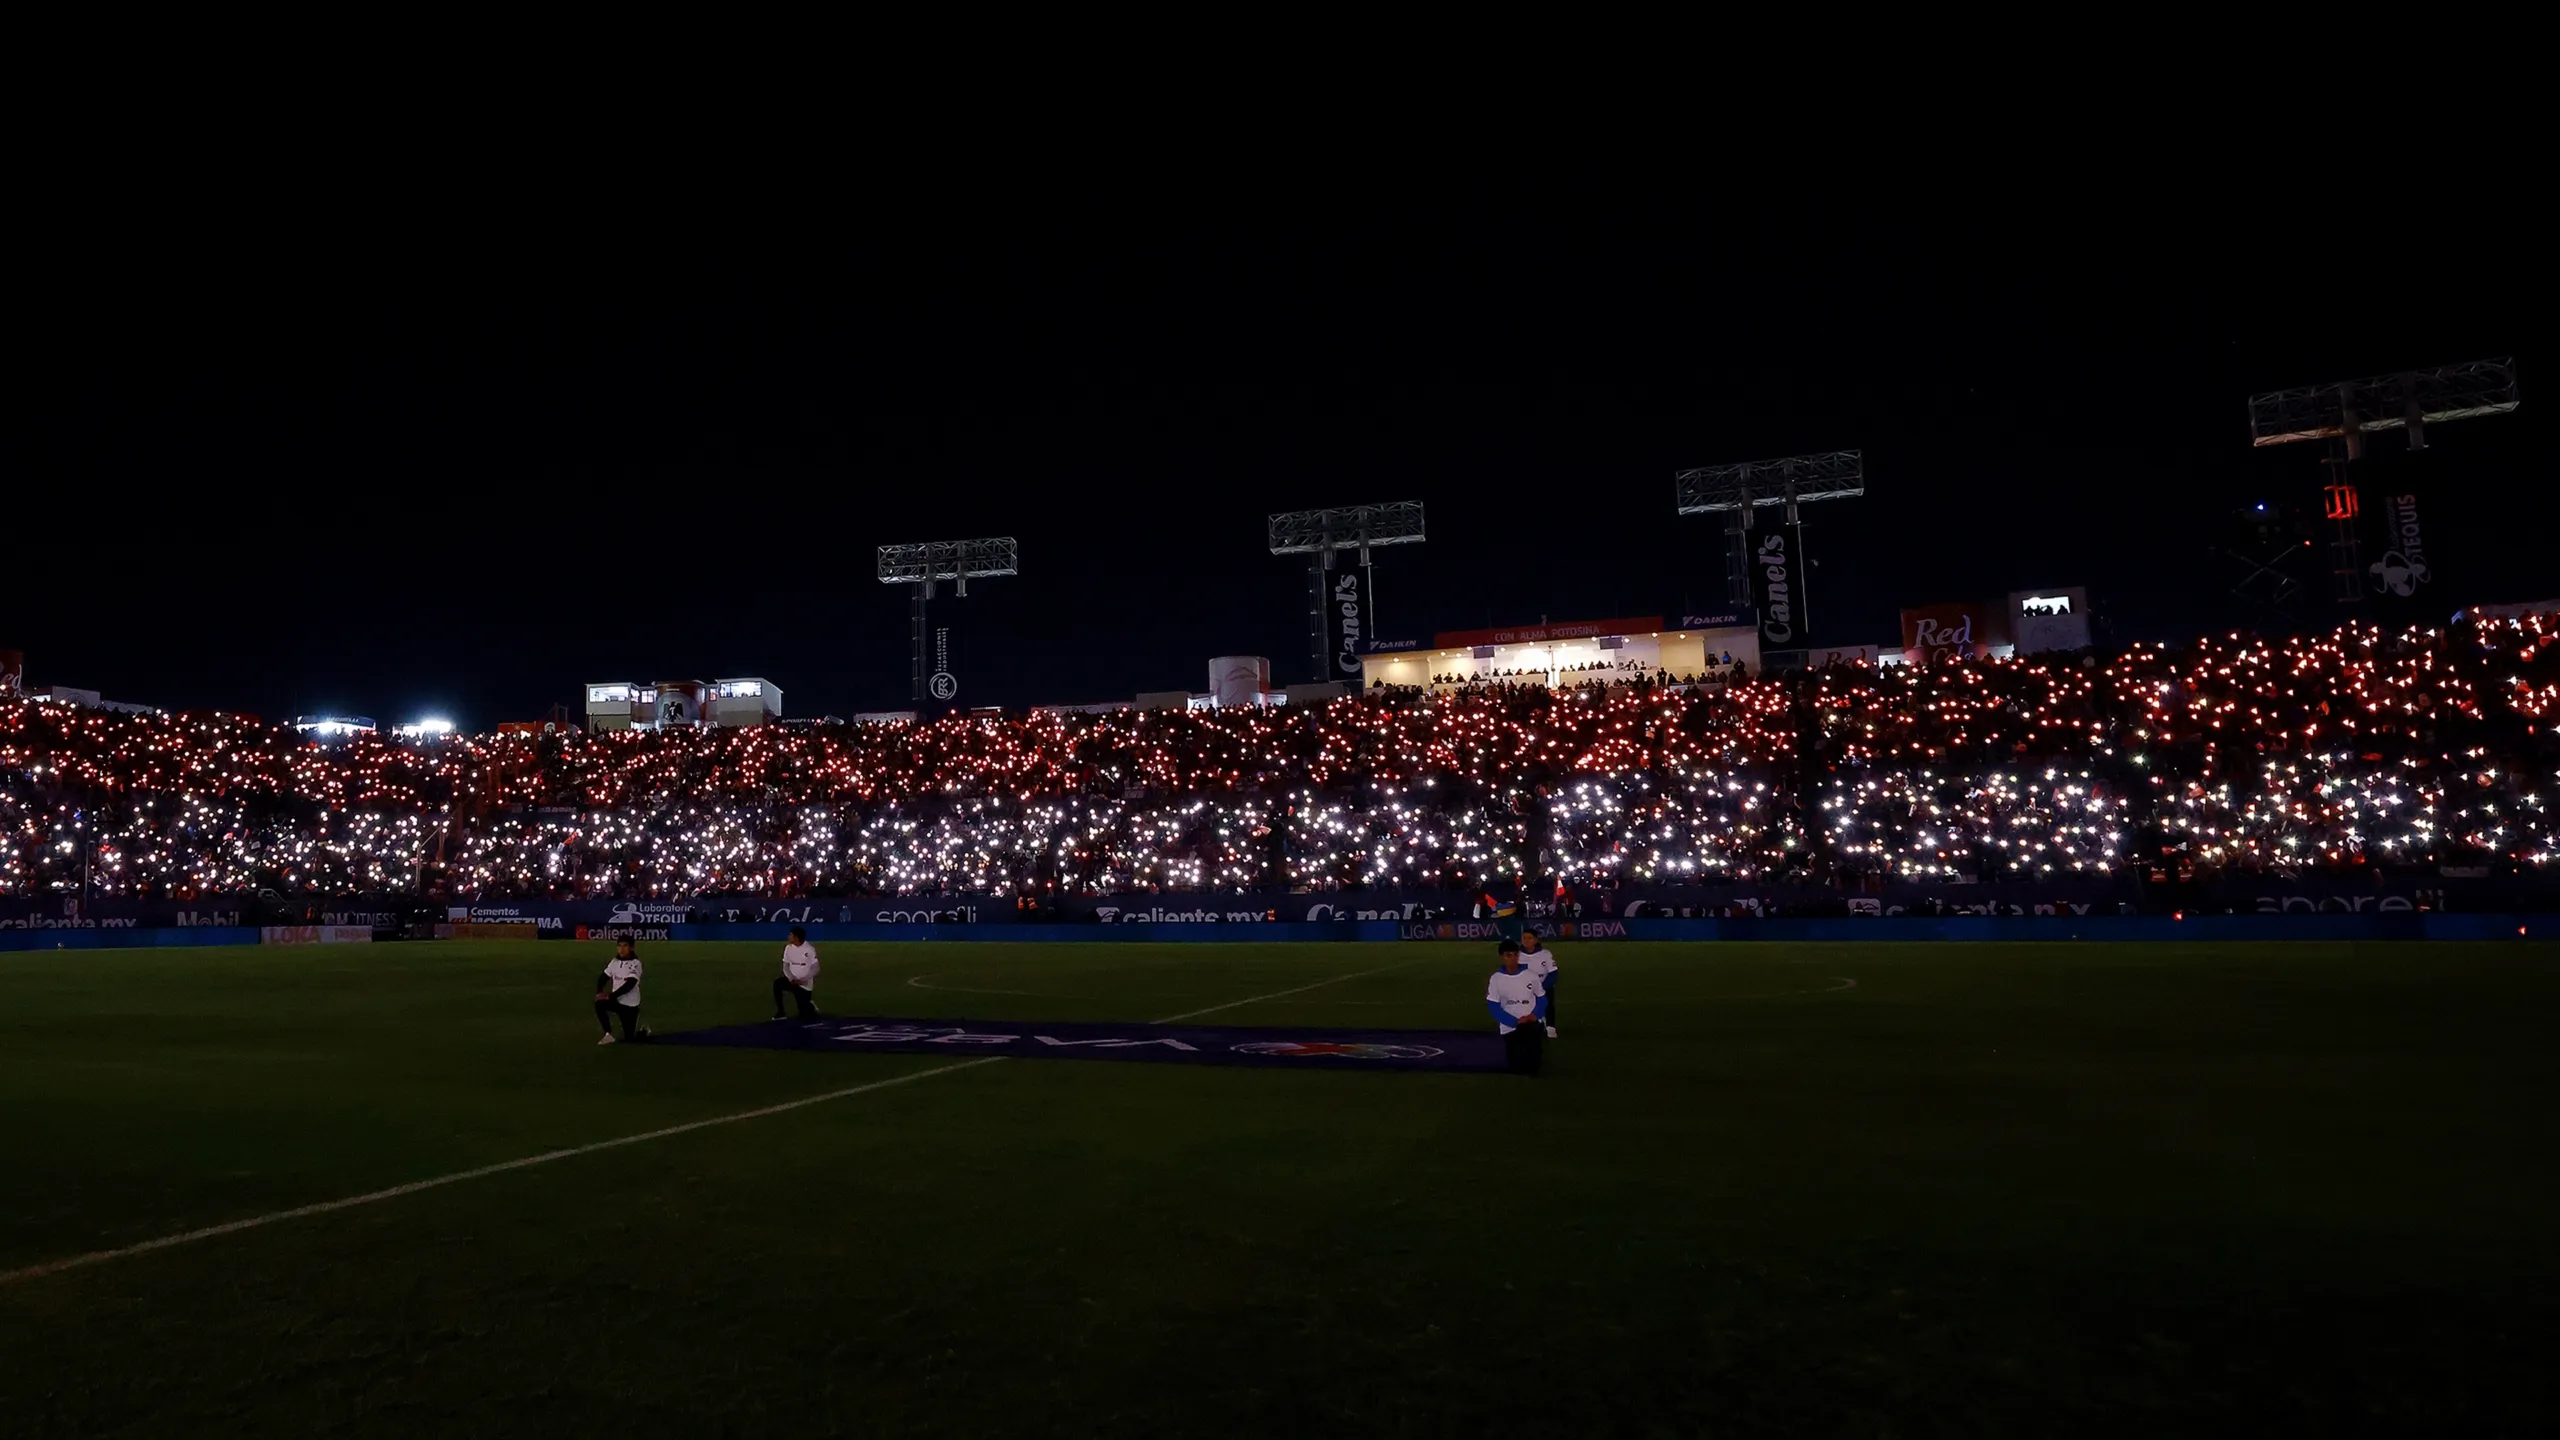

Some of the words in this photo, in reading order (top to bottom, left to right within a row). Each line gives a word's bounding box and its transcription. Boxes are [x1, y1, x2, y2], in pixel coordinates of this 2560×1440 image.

[2396, 494, 2422, 558] TEQUIS
[1757, 534, 1792, 645] Canel's
[1335, 573, 1361, 674] Canel's
[1694, 615, 1738, 625] DAIKIN
[1520, 629, 1547, 641] ALMA
[1913, 614, 1976, 649] Red
[0, 660, 23, 690] ed
[352, 911, 398, 928] ITNESS
[471, 906, 520, 916] Cementos
[1401, 924, 1436, 939] LIGA
[1457, 924, 1501, 938] BBVA
[1580, 923, 1627, 938] BBVA
